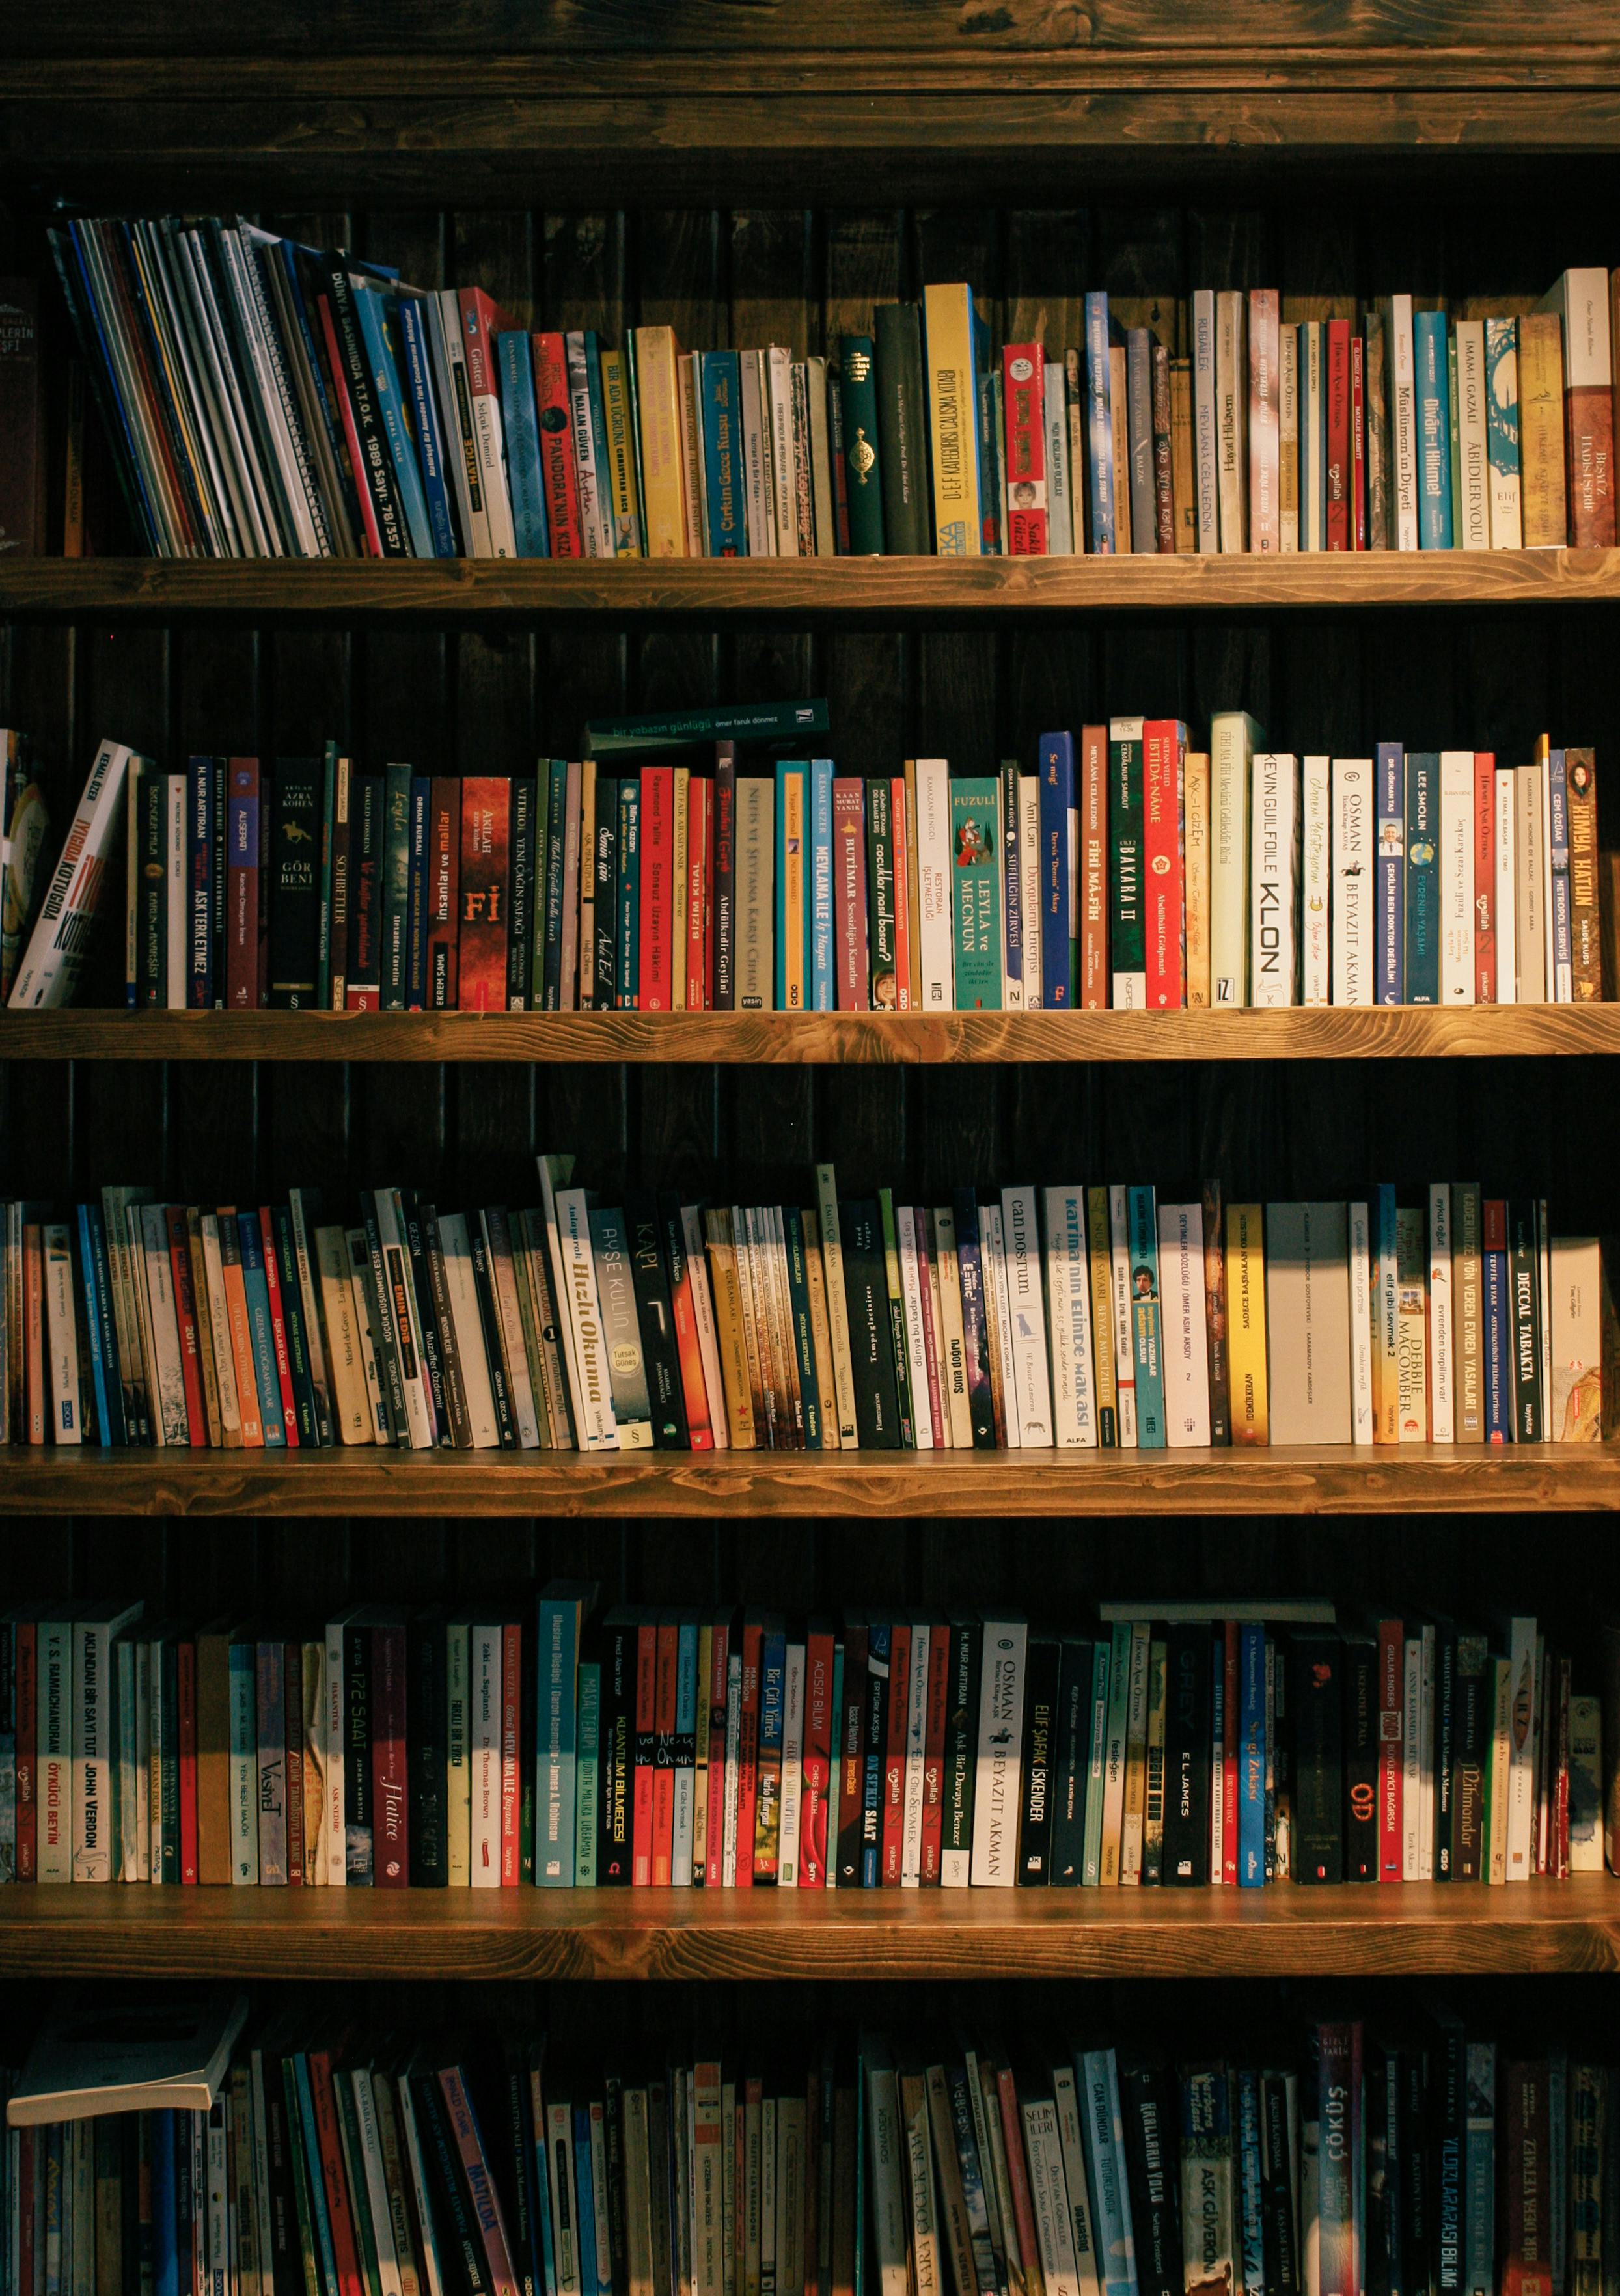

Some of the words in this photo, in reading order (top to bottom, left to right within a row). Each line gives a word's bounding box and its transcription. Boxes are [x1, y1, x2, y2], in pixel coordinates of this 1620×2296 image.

[471, 348, 484, 388] Gösteri
[331, 271, 349, 314] DÜNYA
[357, 383, 373, 427] T.T.O.K.
[366, 435, 383, 469] 1989
[379, 508, 400, 549] 78/357
[477, 402, 490, 432] Selçuk
[575, 394, 587, 425] NALAN
[482, 433, 495, 469] Demirel
[578, 430, 589, 462] GÜVEN
[718, 454, 730, 485] Gece
[1468, 441, 1480, 502] ÂBİDLER
[1399, 472, 1412, 510] Diyeti
[1470, 504, 1481, 541] YOLU
[753, 716, 778, 725] dönmez
[97, 752, 111, 779] KEMAL
[198, 766, 206, 776] H.
[1263, 754, 1277, 794] KEVIN
[1418, 771, 1426, 787] LEE
[87, 780, 102, 801] ÖZER
[1418, 791, 1426, 830] SMOLIN
[439, 812, 450, 851] mallar
[1264, 796, 1277, 873] GUILFOILE
[1572, 806, 1593, 853] KİMYA
[282, 860, 310, 873] GÖR
[440, 853, 448, 866] ve
[516, 838, 525, 861] YENİ
[847, 838, 856, 898] BUTİMAR
[281, 871, 312, 884] BENİ
[335, 855, 346, 923] SOHBETLER
[1120, 847, 1136, 902] BAKARA
[1574, 859, 1592, 907] HATUN
[436, 869, 448, 920] insanlar
[464, 886, 499, 922] Fİ
[979, 879, 991, 929] LEYLA
[720, 895, 728, 950] Abdülkadir
[962, 879, 974, 951] MECNUN
[1259, 884, 1280, 972] KLON
[195, 914, 208, 974] TERKETMEZ
[979, 935, 989, 950] ve
[437, 953, 445, 977] ŞAMA
[1013, 1200, 1024, 1227] can
[409, 1222, 420, 1256] GEZGİN
[602, 1229, 619, 1272] AYŞE
[636, 1223, 655, 1270] KAPI
[1464, 1260, 1476, 1281] YÖN
[1464, 1285, 1475, 1317] VEREN
[1518, 1272, 1531, 1318] DECCAL
[185, 1326, 197, 1354] 2014
[571, 1263, 589, 1318] Hızlı
[581, 1322, 601, 1403] Okuma
[914, 1324, 920, 1336] bu
[1465, 1322, 1475, 1354] EVREN
[426, 1331, 436, 1369] Muzaffer
[431, 1371, 443, 1408] Özdemir
[952, 1339, 961, 1367] doğru
[1399, 1320, 1412, 1412] MACOMBER
[1412, 1339, 1422, 1394] DEBBIE
[1519, 1325, 1533, 1382] TABAKTA
[954, 1371, 964, 1393] Sona
[1466, 1359, 1476, 1409] YASALARI
[84, 1632, 96, 1686] AKLINDAN
[767, 1668, 780, 1684] Bir
[84, 1689, 96, 1704] BİR
[767, 1686, 780, 1704] Çift
[814, 1660, 824, 1697] ACISIZ
[1004, 1661, 1016, 1720] OSMAN
[49, 1663, 60, 1753] RAMACHANDRAN
[84, 1708, 96, 1736] SAYI
[765, 1709, 779, 1738] Yürek
[813, 1701, 825, 1730] BİLİM
[351, 1707, 366, 1749] SAAT
[85, 1737, 96, 1757] TUT
[868, 1755, 879, 1770] ON
[955, 1754, 966, 1770] Bir
[48, 1763, 59, 1807] ÖYKÜCÜ
[85, 1763, 96, 1796] JOHN
[762, 1773, 774, 1797] Marlo
[866, 1772, 879, 1807] SEKİZ
[953, 1772, 965, 1806] Davaya
[992, 1751, 1006, 1814] BEYAZIT
[1030, 1769, 1047, 1821] İSKENDER
[381, 1776, 402, 1840] Hatice
[614, 1779, 625, 1842] BİLMECESİ
[760, 1799, 772, 1826] Morgan
[1351, 1782, 1374, 1822] OD
[48, 1811, 60, 1844] BEYİN
[85, 1799, 96, 1848] VERDON
[865, 1810, 877, 1840] SAAT
[952, 1809, 963, 1846] Benzer
[989, 1819, 1002, 1876] AKMAN
[1093, 2084, 1102, 2103] CAN
[1095, 2103, 1108, 2144] DÜNDAR
[1328, 2086, 1348, 2161] ÇÖKÜŞ
[466, 2164, 497, 2233] MATILDA
[1440, 2138, 1458, 2245] YILDIZLARARASI
[918, 2239, 933, 2291] KARA
